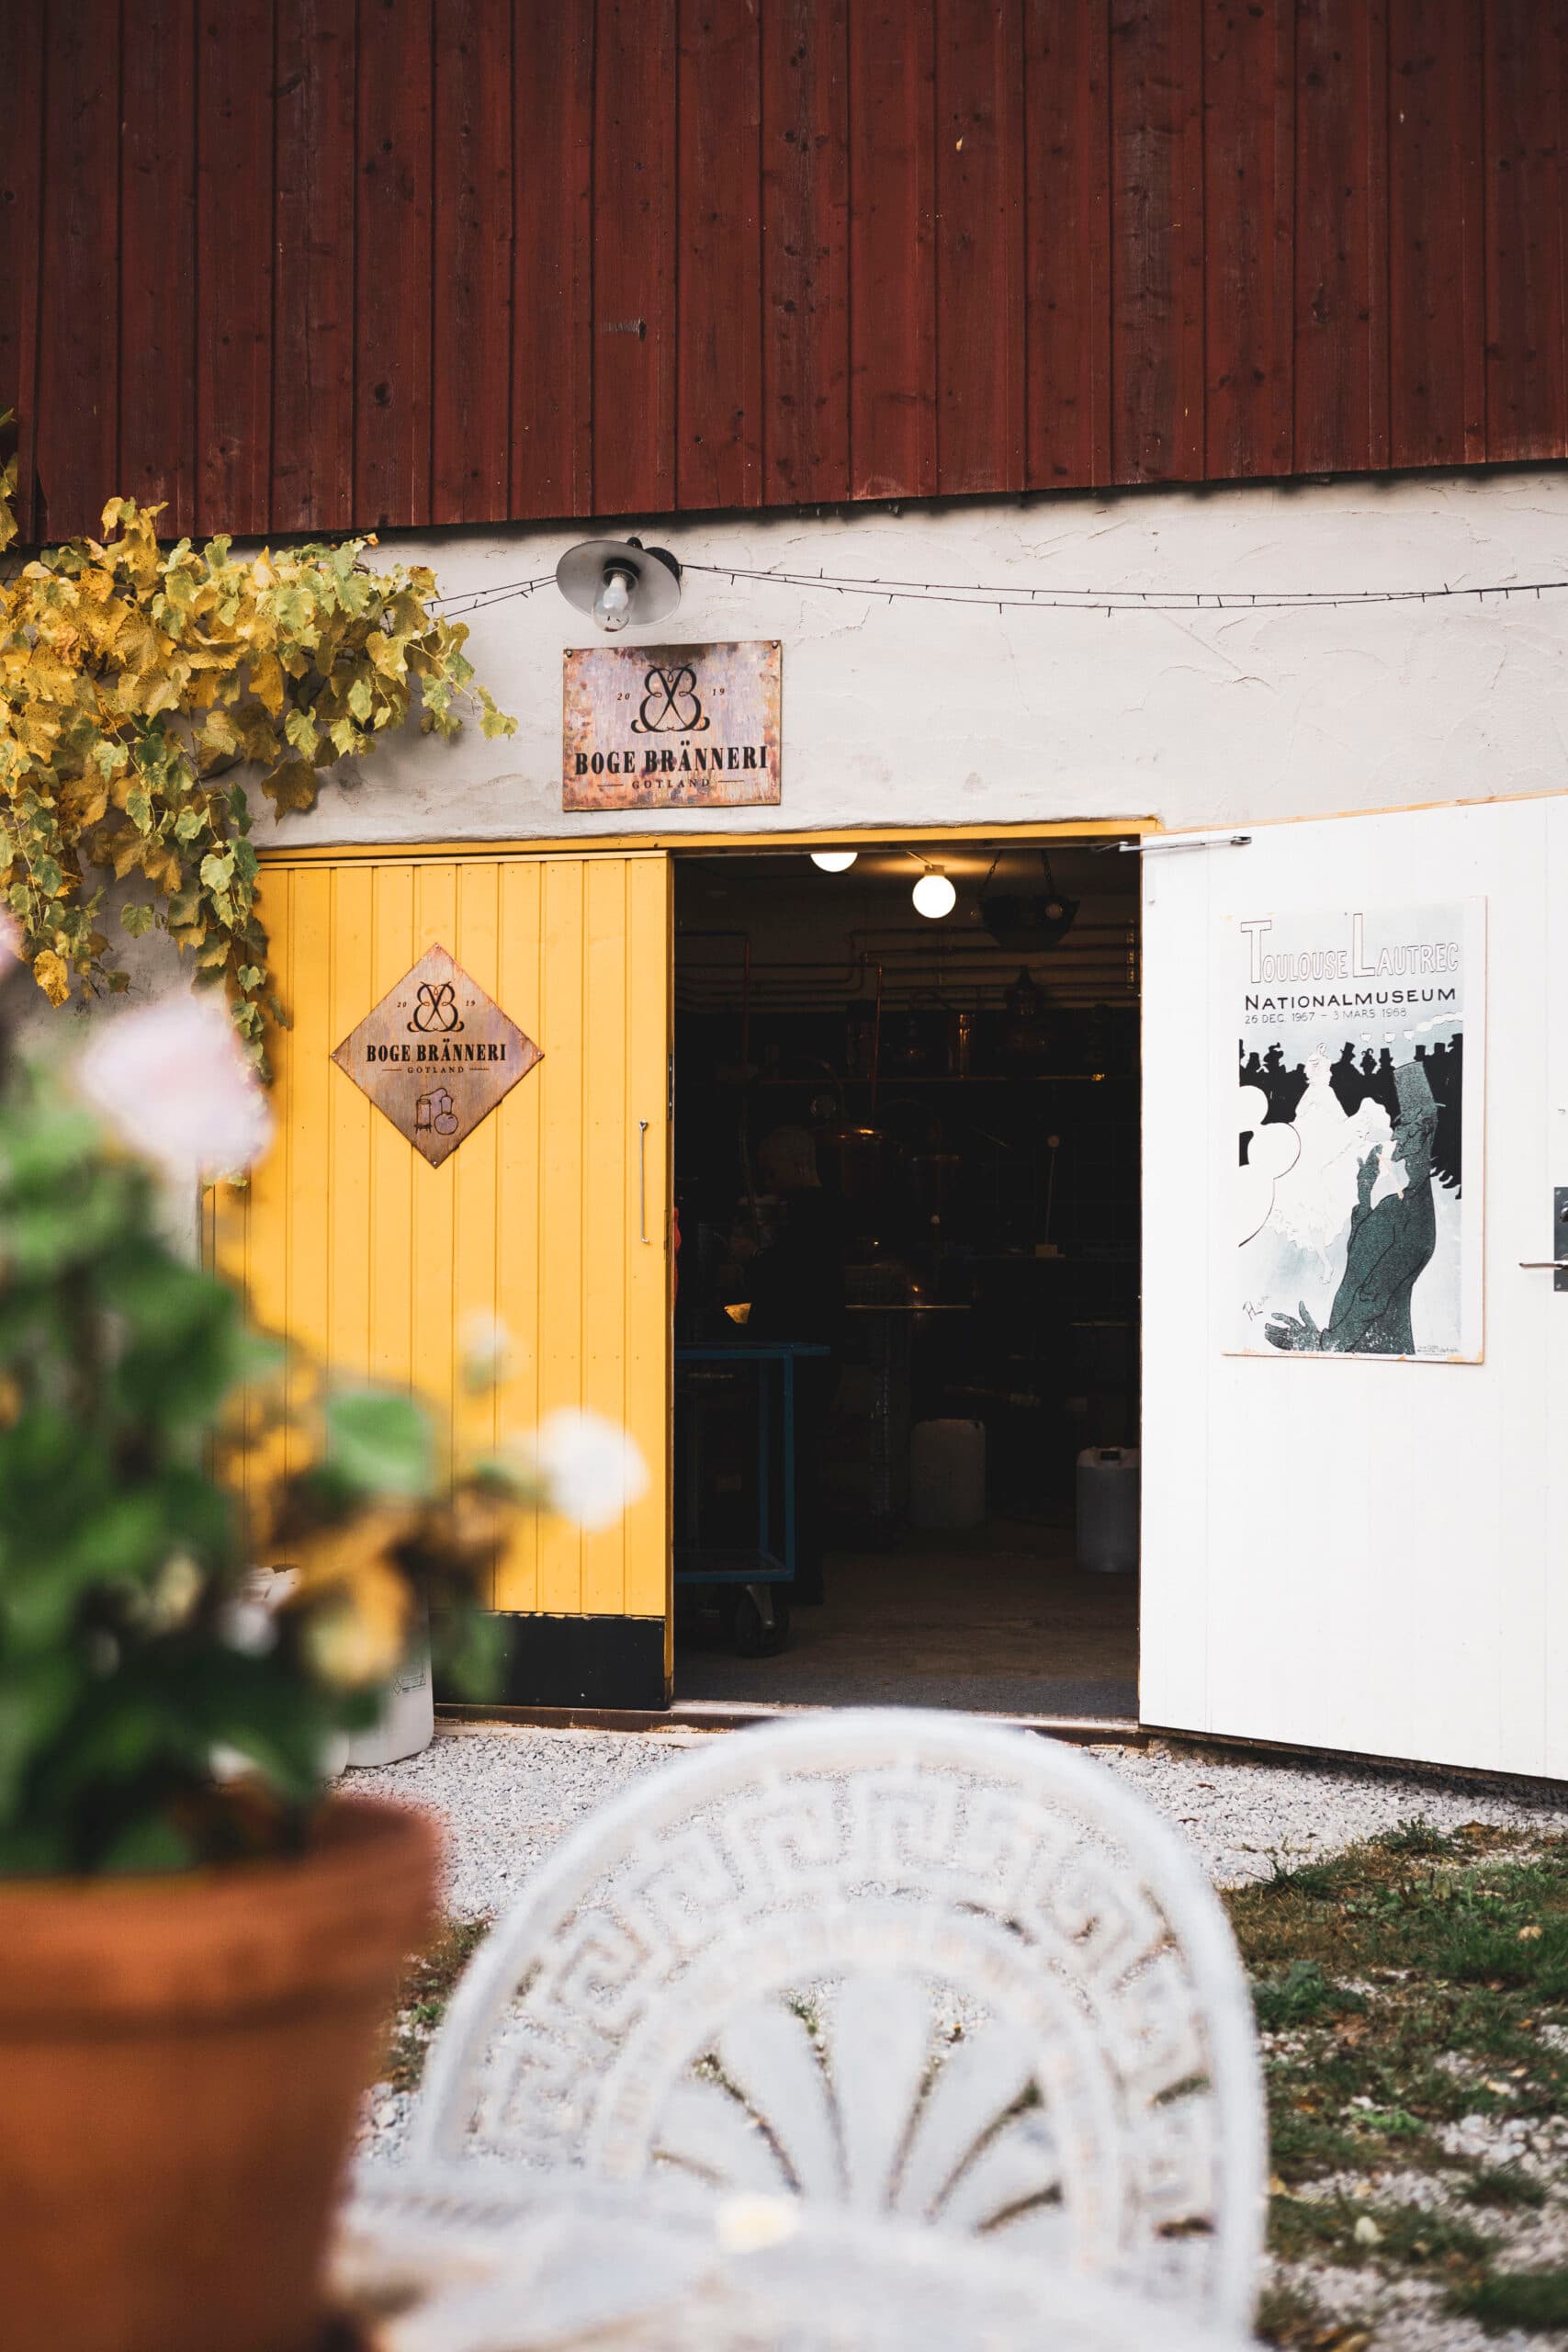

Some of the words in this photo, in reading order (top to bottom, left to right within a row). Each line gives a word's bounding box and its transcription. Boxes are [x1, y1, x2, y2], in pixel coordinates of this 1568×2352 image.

[616, 692, 630, 701] 20
[712, 687, 725, 696] 19
[574, 750, 636, 775] BOGE
[645, 740, 768, 774] BRÄNNERI
[632, 778, 710, 789] GOTLAND
[1245, 988, 1456, 1012] NATIONALMUSEUM
[1245, 1013, 1258, 1024] 26
[1292, 1012, 1315, 1022] 1967
[1334, 1011, 1339, 1021] 3
[1343, 1009, 1375, 1020] MARS
[1382, 1007, 1407, 1018] 1968
[366, 1044, 411, 1062] BOGE
[417, 1038, 506, 1061] BRÄNNERI
[407, 1066, 465, 1074] GOTLAND
